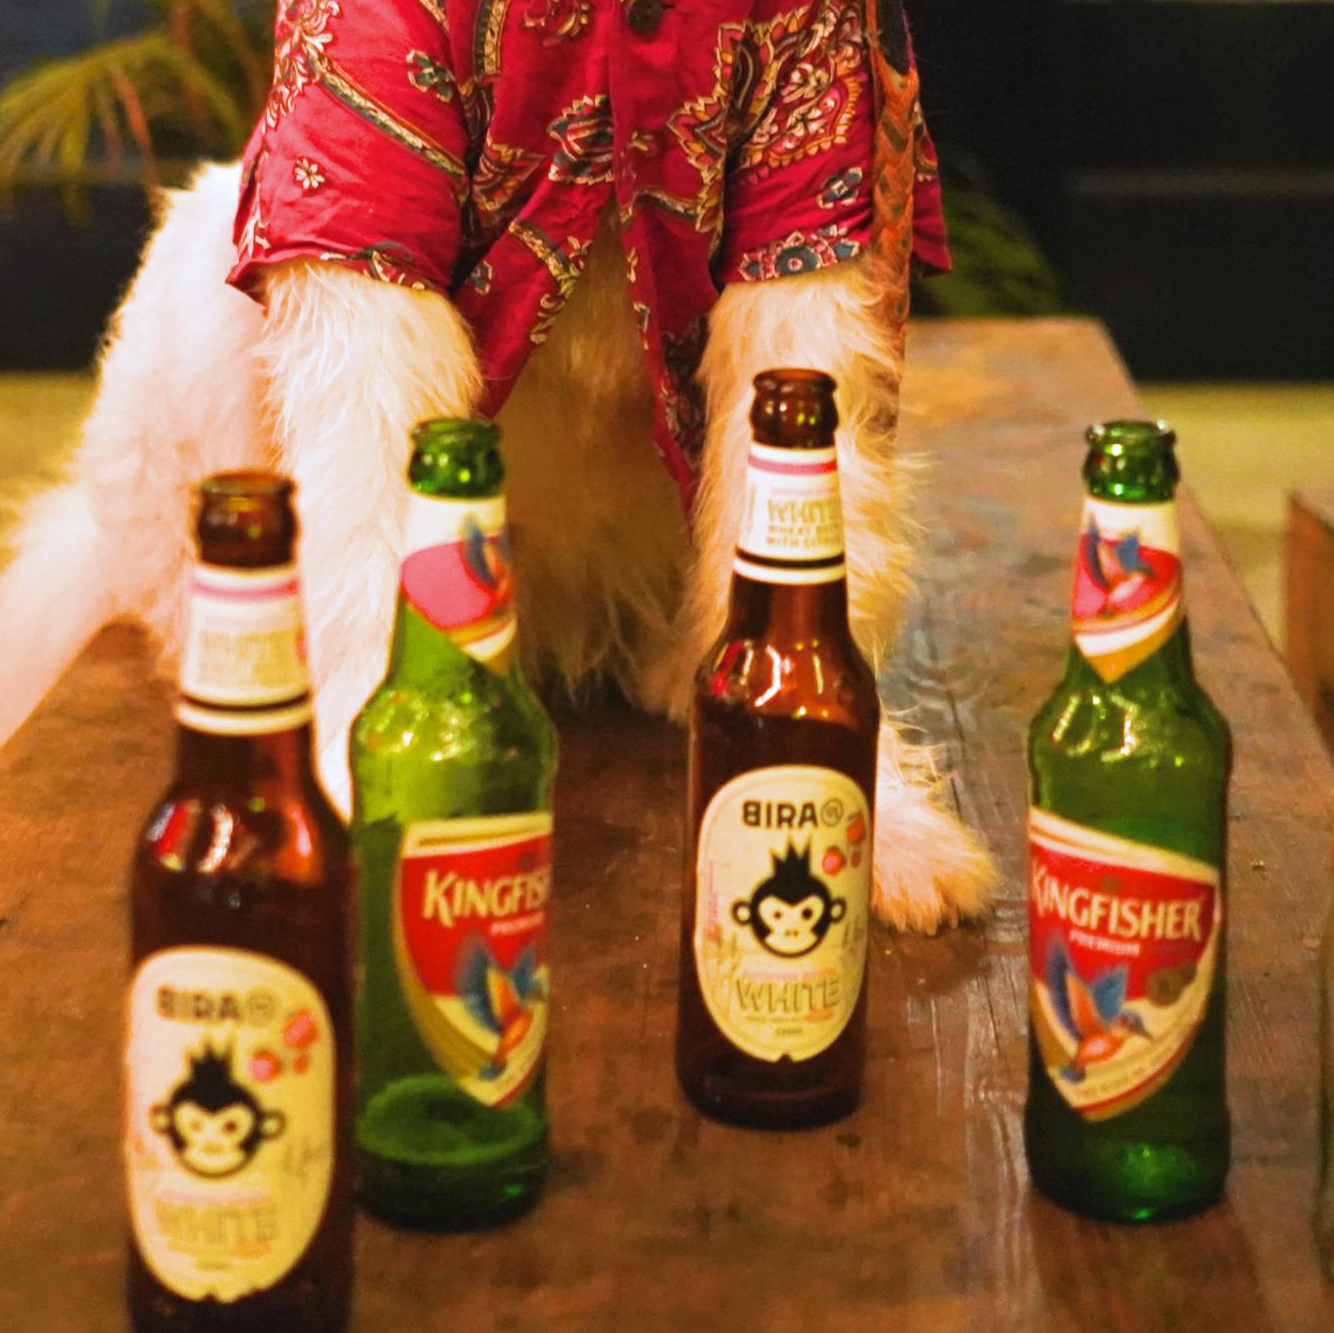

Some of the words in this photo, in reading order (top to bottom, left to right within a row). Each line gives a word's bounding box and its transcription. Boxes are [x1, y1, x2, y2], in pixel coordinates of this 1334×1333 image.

[742, 799, 819, 829] BIRA
[1031, 860, 1204, 942] KINGFISHER
[156, 983, 243, 1022] BIRA
[735, 978, 840, 1013] WHITE
